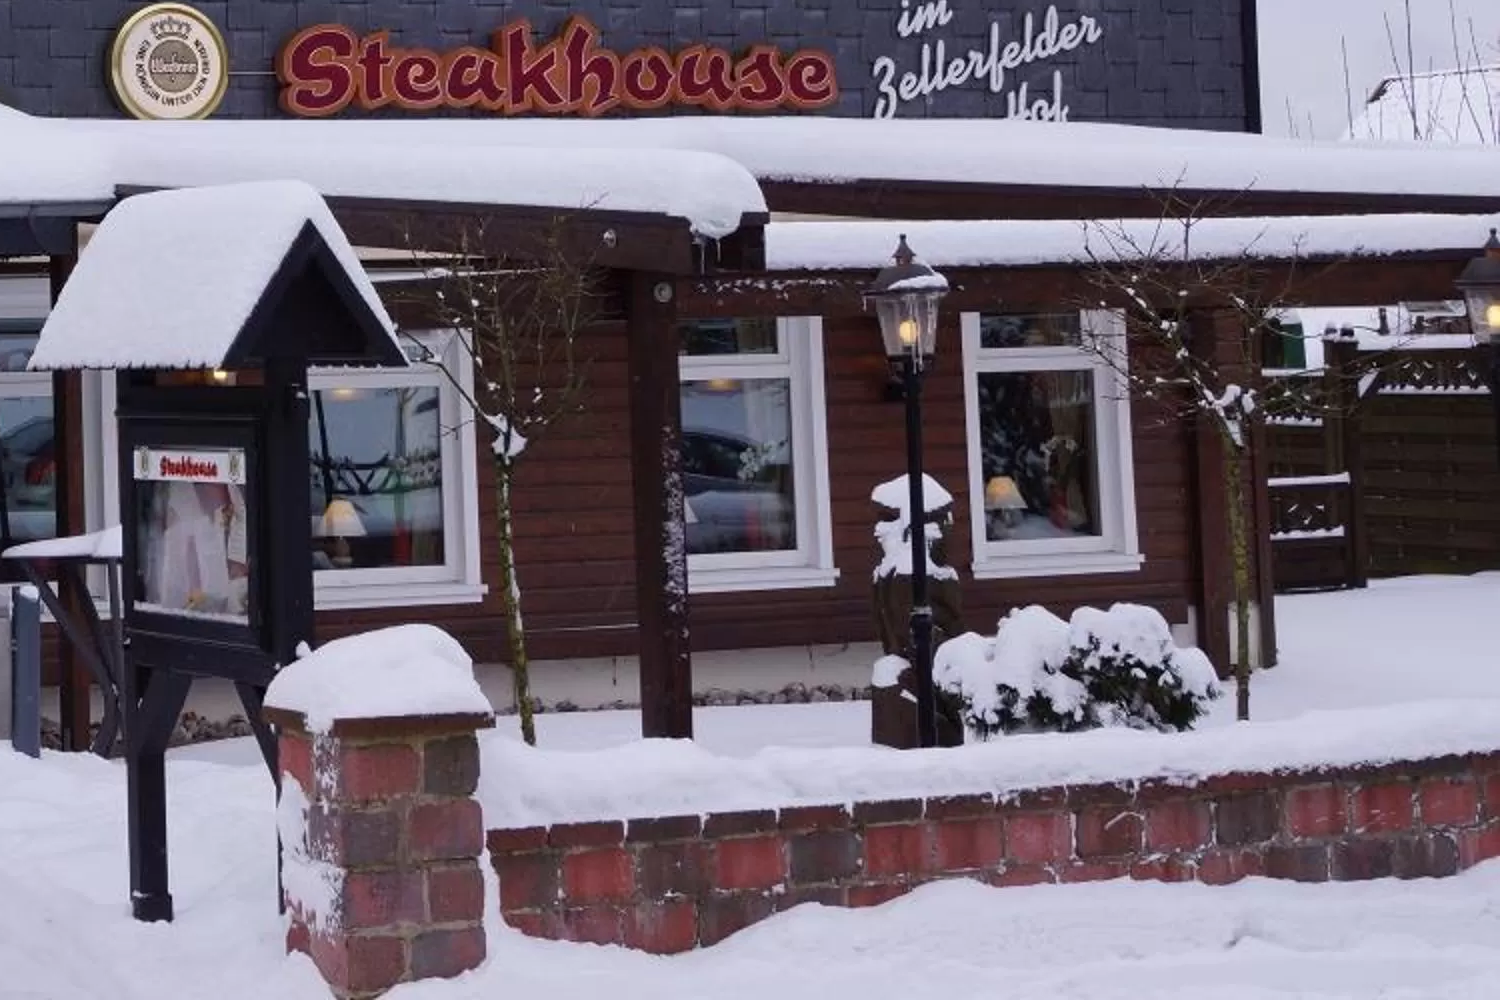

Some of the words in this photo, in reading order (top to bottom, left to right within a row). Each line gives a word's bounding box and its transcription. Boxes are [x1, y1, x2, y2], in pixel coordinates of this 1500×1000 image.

[286, 19, 836, 114] Steakhouse
[873, 4, 1102, 120] Zellerfelder
[160, 455, 218, 477] Steakhouse
